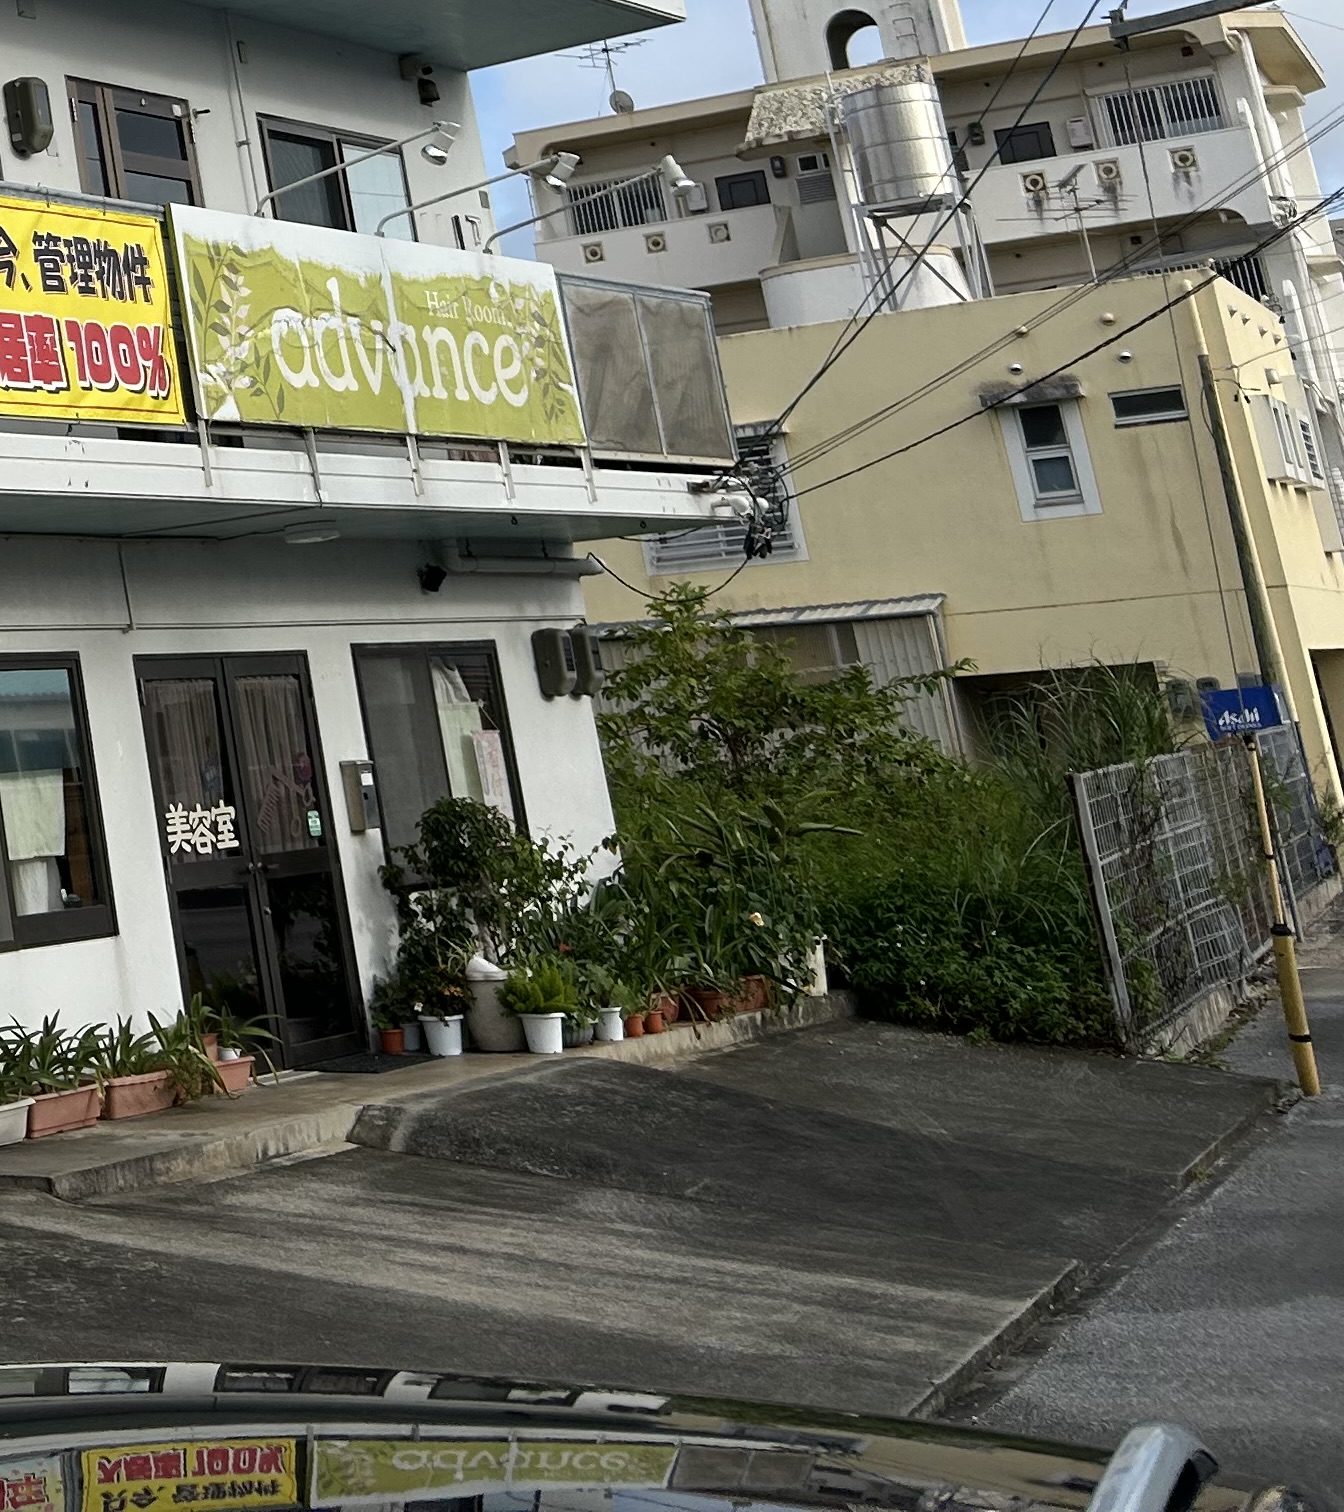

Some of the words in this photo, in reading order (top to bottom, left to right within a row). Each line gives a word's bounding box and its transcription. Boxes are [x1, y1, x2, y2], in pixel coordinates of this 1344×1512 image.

[425, 290, 459, 320] Hair
[462, 295, 507, 326] Room
[270, 277, 529, 408] advance
[1218, 706, 1260, 726] Asahi
[165, 799, 240, 855] 美容室
